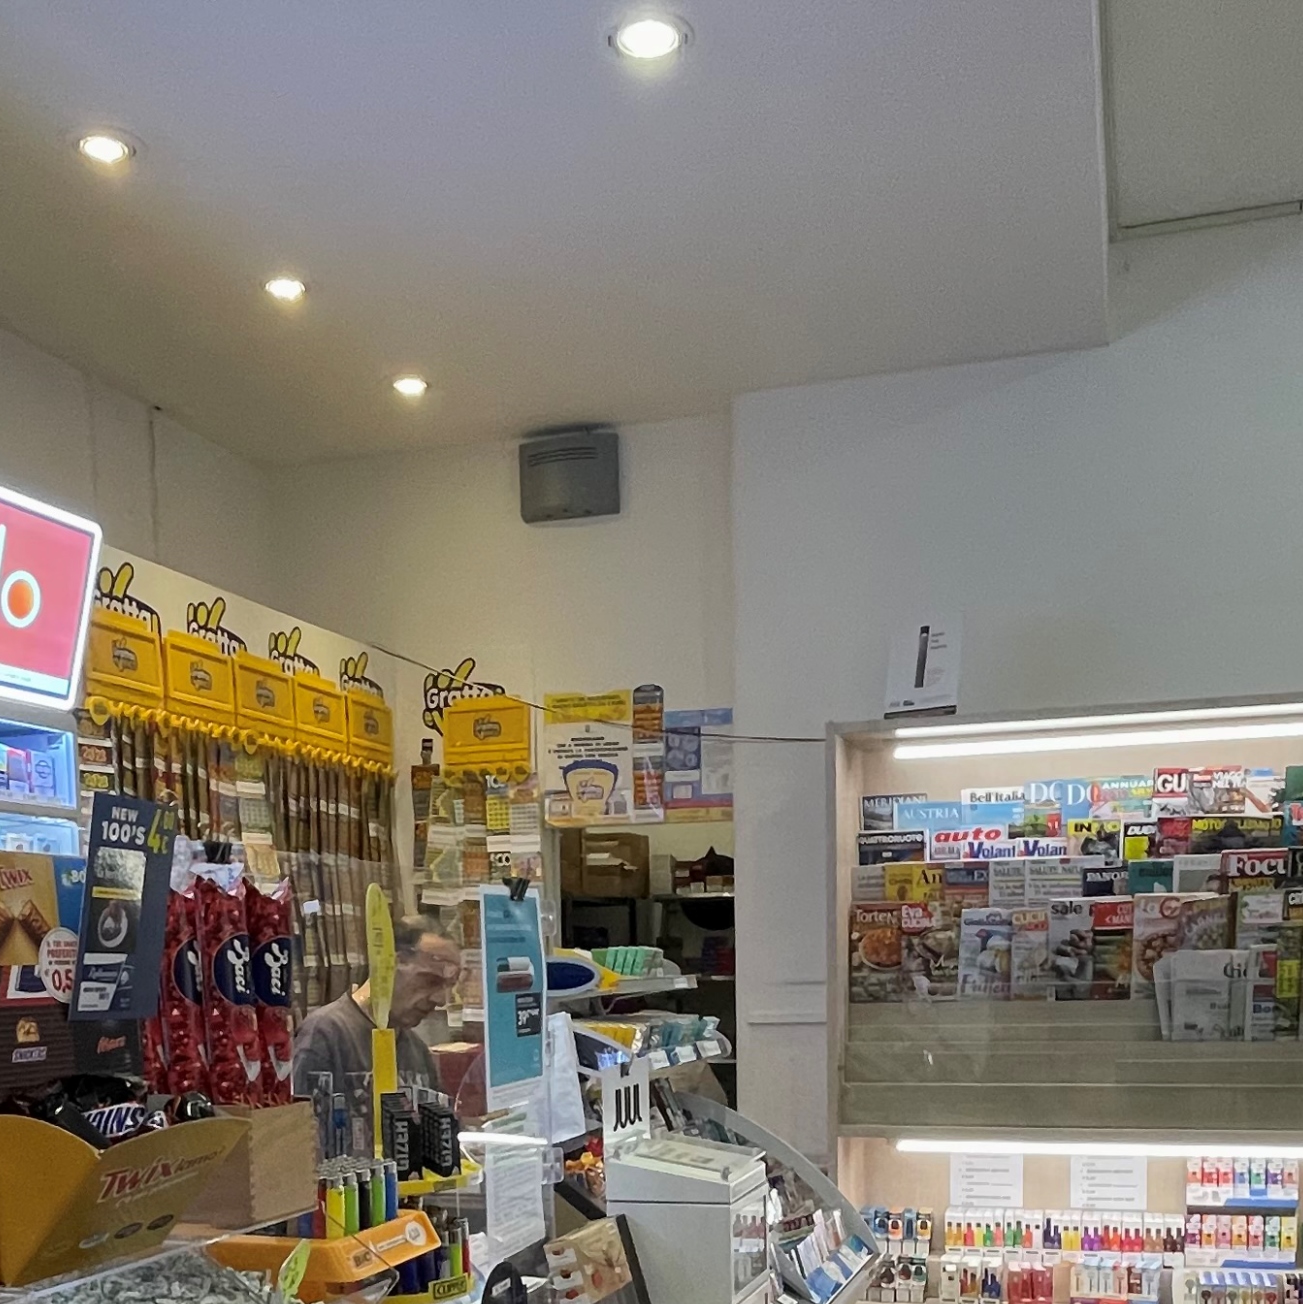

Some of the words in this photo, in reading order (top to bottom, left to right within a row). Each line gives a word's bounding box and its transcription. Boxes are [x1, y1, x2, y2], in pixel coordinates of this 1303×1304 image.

[970, 791, 1026, 803] Bell'Italia
[111, 806, 139, 822] NEW
[902, 808, 960, 820] AUSTRIA
[101, 820, 146, 844] 100'S
[934, 827, 1002, 843] auto
[1051, 901, 1083, 915] sale
[225, 938, 250, 996] Baci
[265, 938, 290, 997] Baci
[395, 1119, 410, 1172] GIZEH
[439, 1116, 453, 1167] GIZEH
